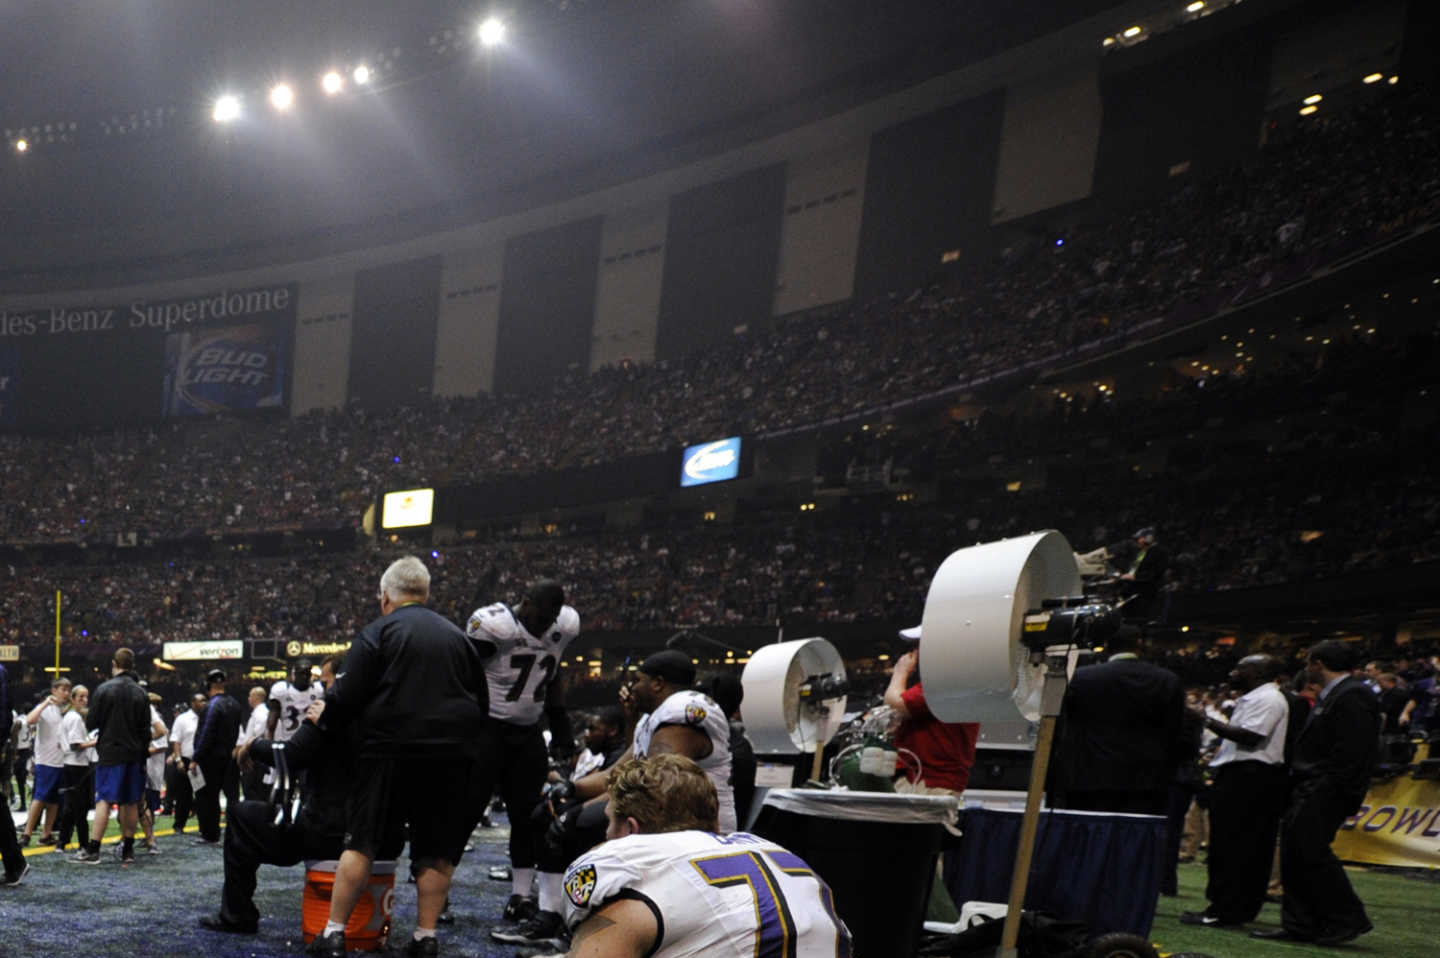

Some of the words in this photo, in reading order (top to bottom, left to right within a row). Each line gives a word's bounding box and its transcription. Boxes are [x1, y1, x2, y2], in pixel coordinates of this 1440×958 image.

[128, 285, 291, 333] Superdome
[195, 347, 268, 369] BUD
[181, 366, 272, 386] LIGHT
[199, 645, 240, 660] verizon
[505, 654, 556, 704] 72
